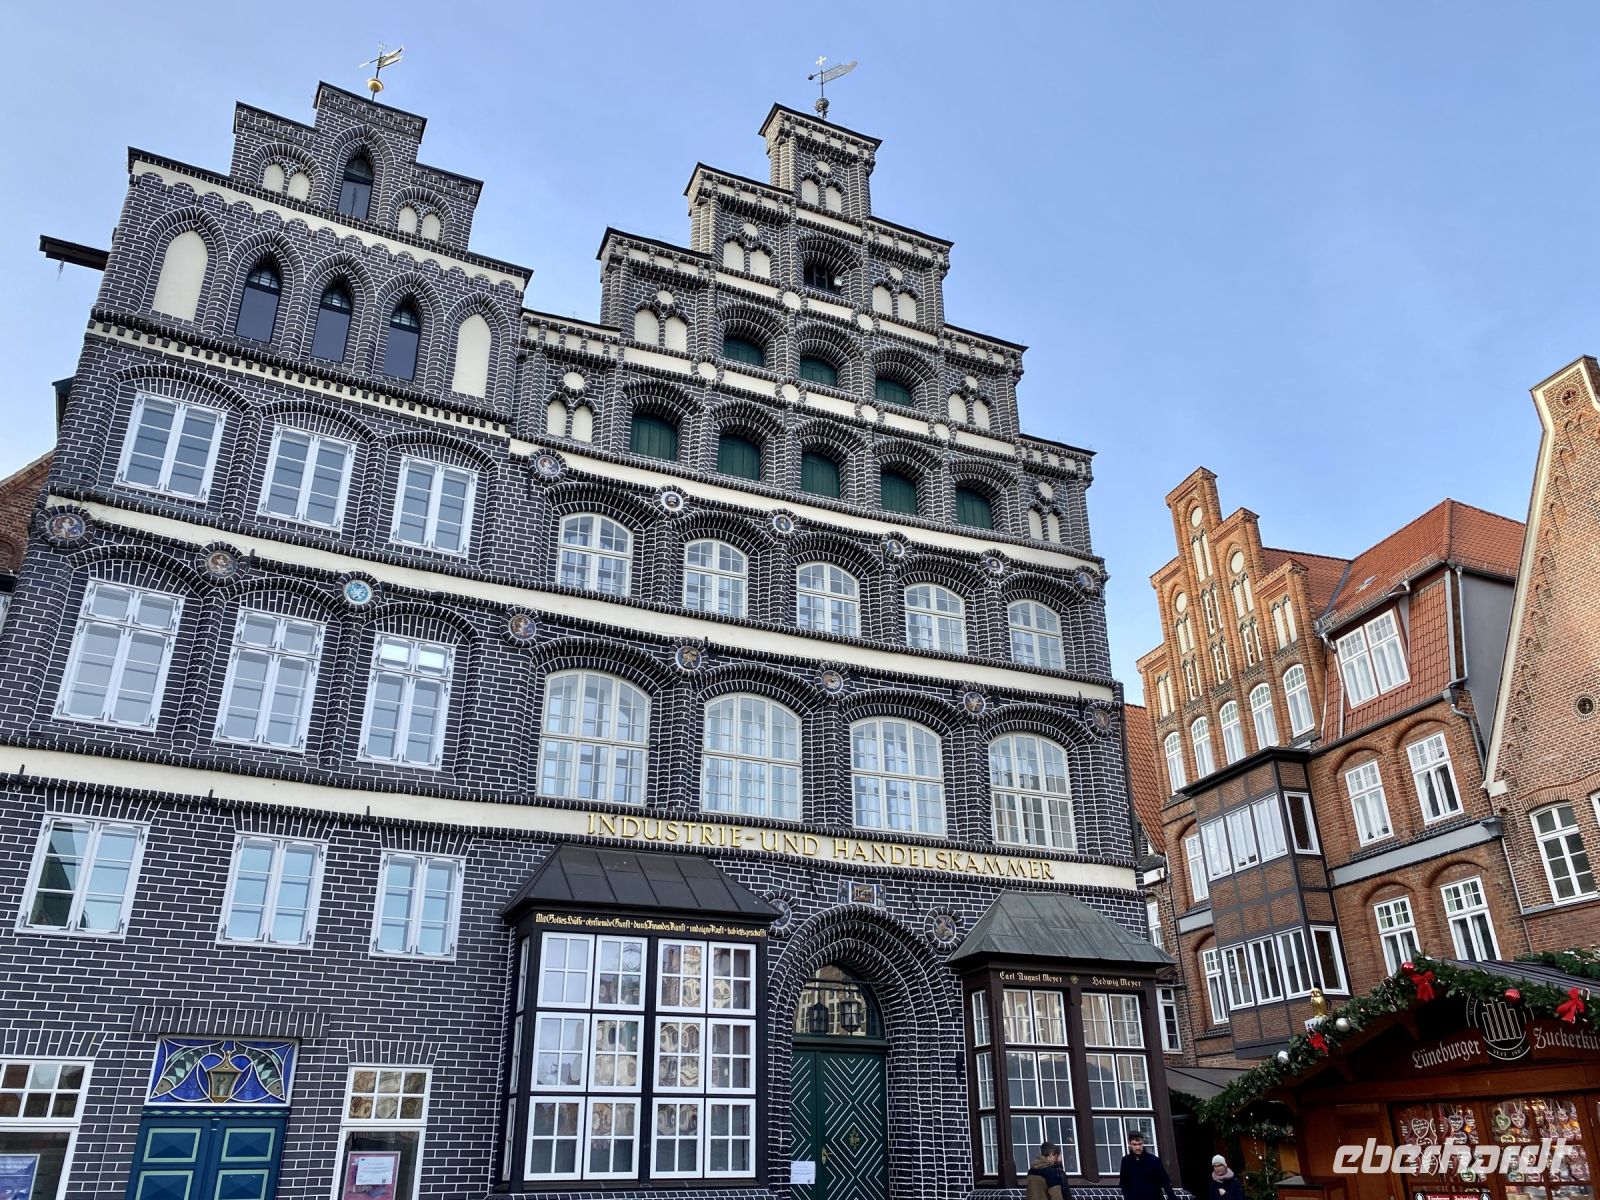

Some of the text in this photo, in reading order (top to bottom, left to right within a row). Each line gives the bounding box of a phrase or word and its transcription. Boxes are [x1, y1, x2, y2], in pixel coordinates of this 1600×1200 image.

[832, 838, 1055, 880] HANDELSKAMMER
[1000, 970, 1063, 984] Carl August Meyer
[1092, 976, 1142, 988] Hedwig Meyer
[1411, 1026, 1600, 1069] Lüneburger Zuckerkü
